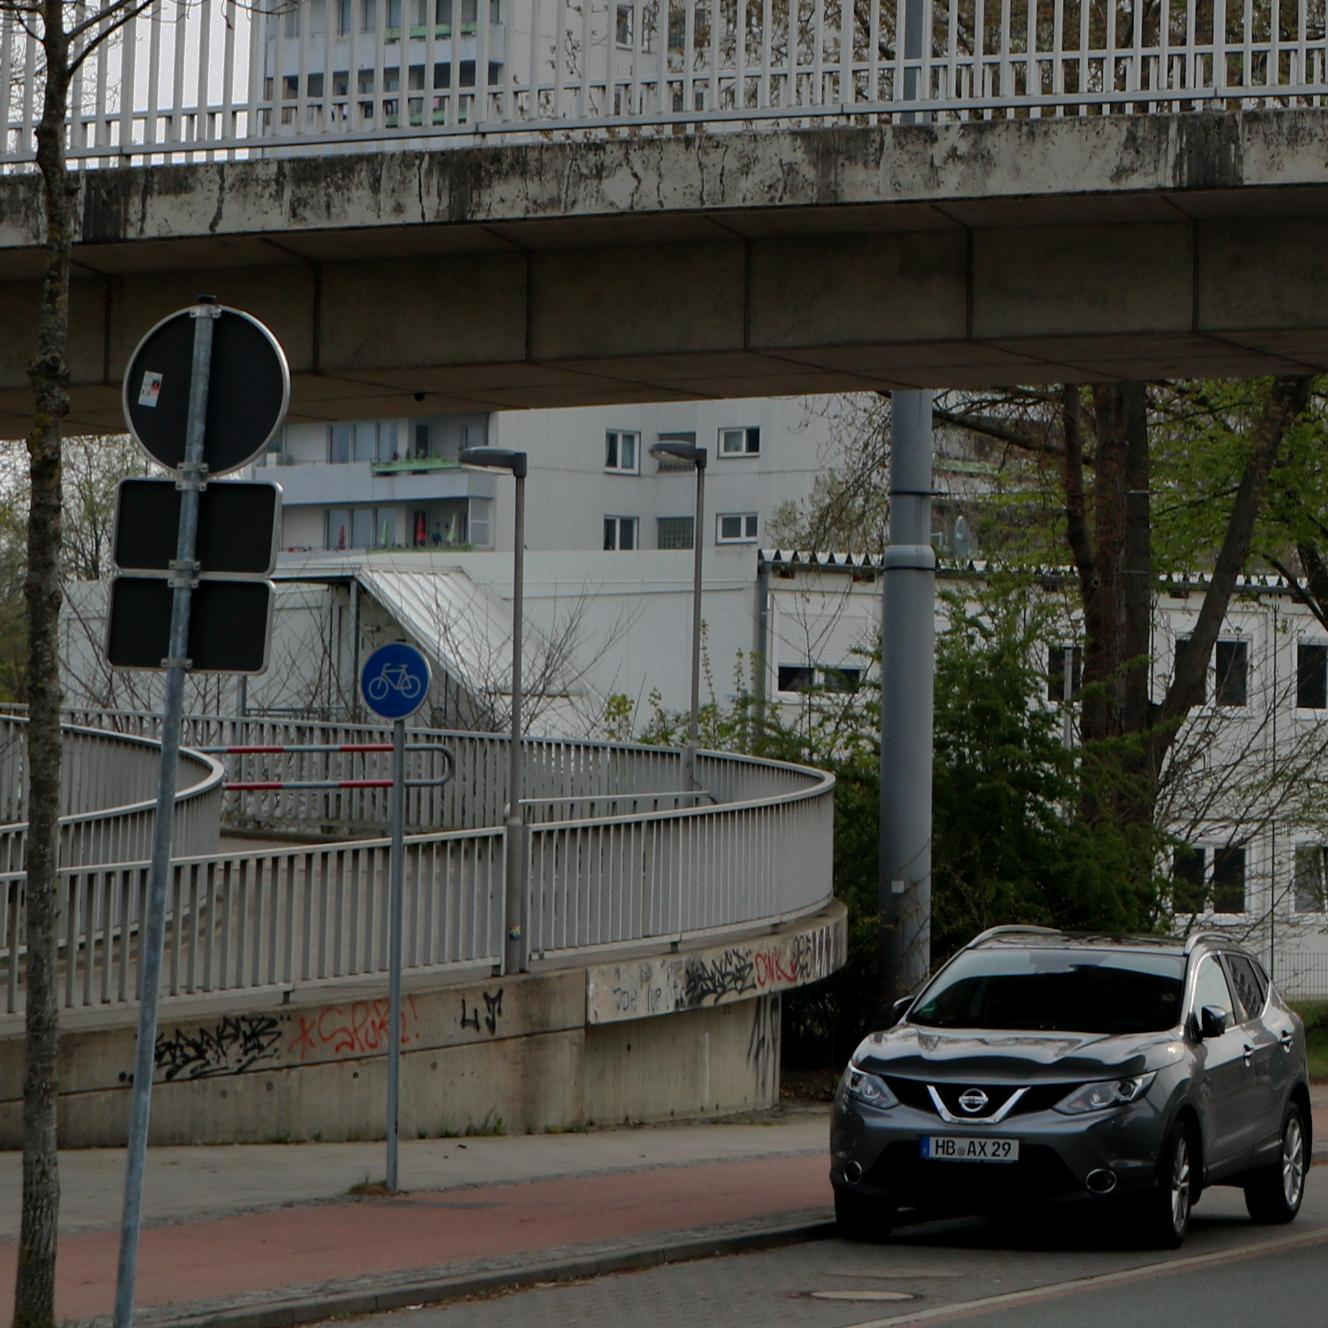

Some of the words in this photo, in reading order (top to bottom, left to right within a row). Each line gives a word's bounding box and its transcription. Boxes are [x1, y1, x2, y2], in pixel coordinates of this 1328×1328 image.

[935, 1139, 956, 1156] HB
[967, 1140, 988, 1157] AX
[991, 1141, 1012, 1158] 29
